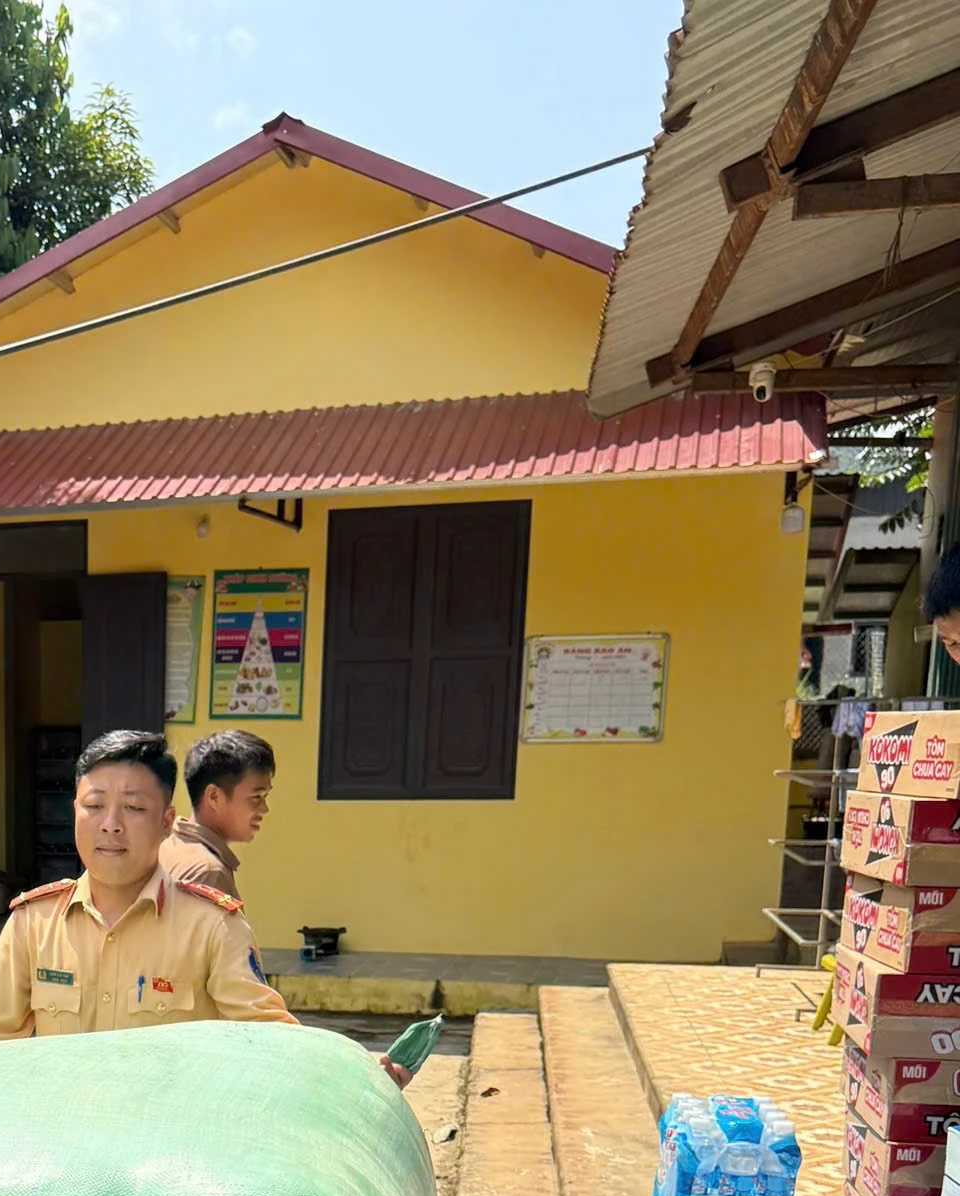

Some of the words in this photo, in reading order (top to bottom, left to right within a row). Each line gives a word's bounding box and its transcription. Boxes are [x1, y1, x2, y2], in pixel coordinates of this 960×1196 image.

[868, 735, 913, 764] KOKOMI
[927, 736, 945, 758] TÔM
[880, 766, 895, 788] 90
[912, 761, 934, 779] CHUA
[934, 761, 954, 780] CAY
